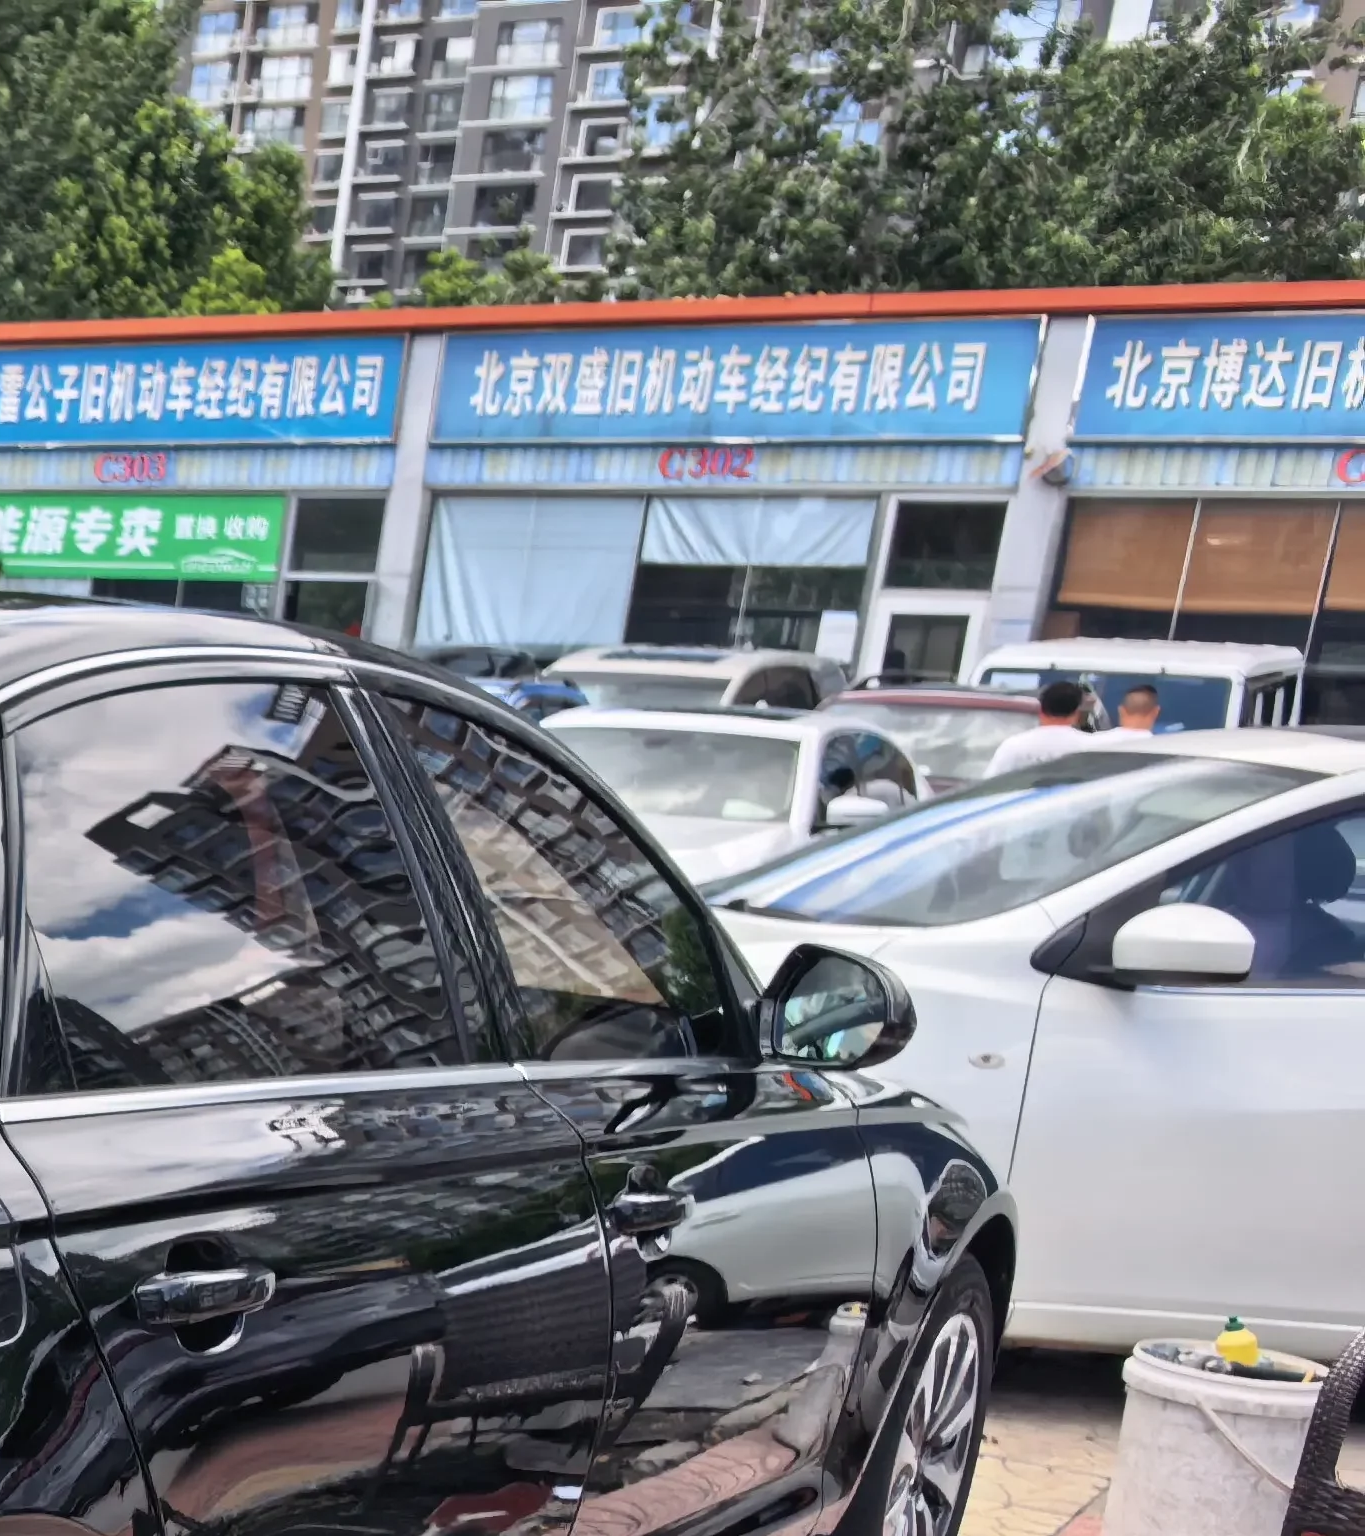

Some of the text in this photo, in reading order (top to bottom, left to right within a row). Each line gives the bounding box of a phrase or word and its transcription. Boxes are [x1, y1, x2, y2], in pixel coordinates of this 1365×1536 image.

[470, 341, 987, 418] 北京双盛旧机动车经纪有限公司
[93, 452, 167, 483] C303
[658, 447, 755, 480] C302
[173, 514, 218, 540] 置换
[224, 513, 271, 541] 收购
